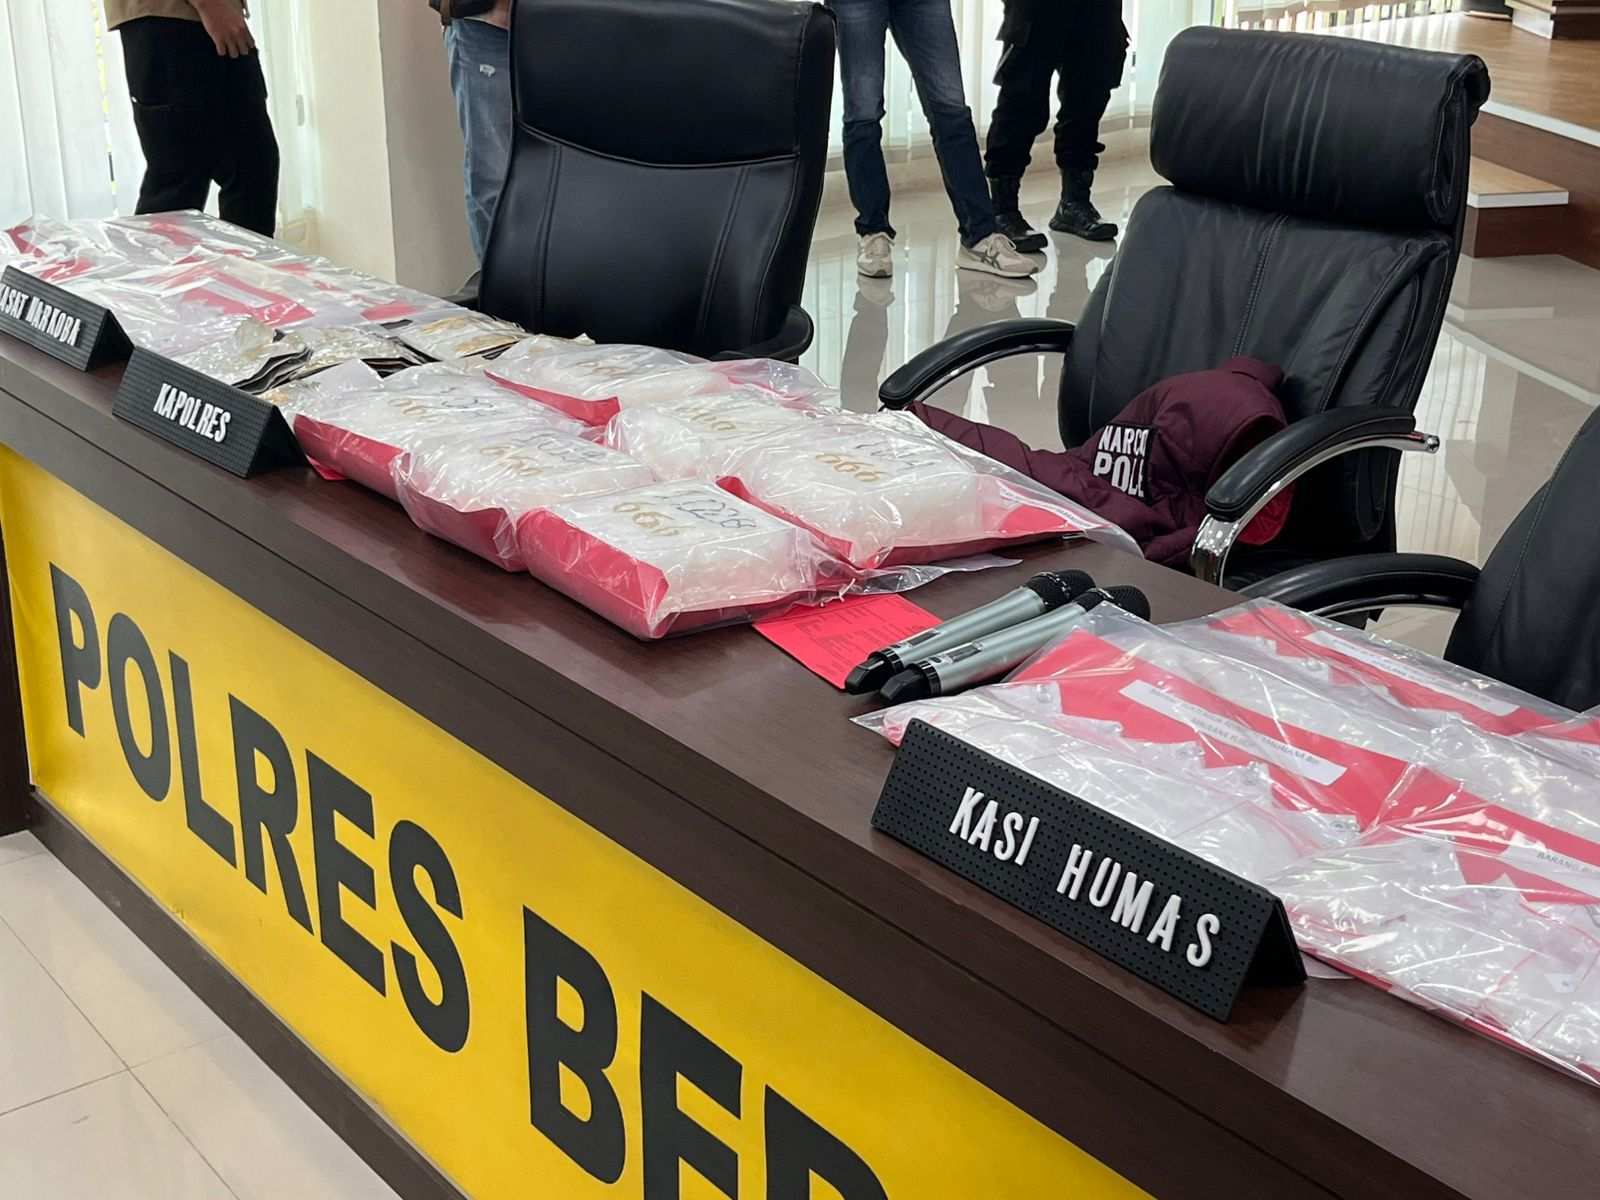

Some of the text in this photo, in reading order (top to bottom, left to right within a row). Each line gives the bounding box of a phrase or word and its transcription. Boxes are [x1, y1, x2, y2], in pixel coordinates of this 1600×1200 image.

[25, 296, 81, 347] NARKOBA
[153, 383, 231, 442] KAPOLRES
[1098, 425, 1149, 457] NARCO
[49, 561, 470, 1054] POLRES
[949, 786, 1221, 968] KASI HUMAS
